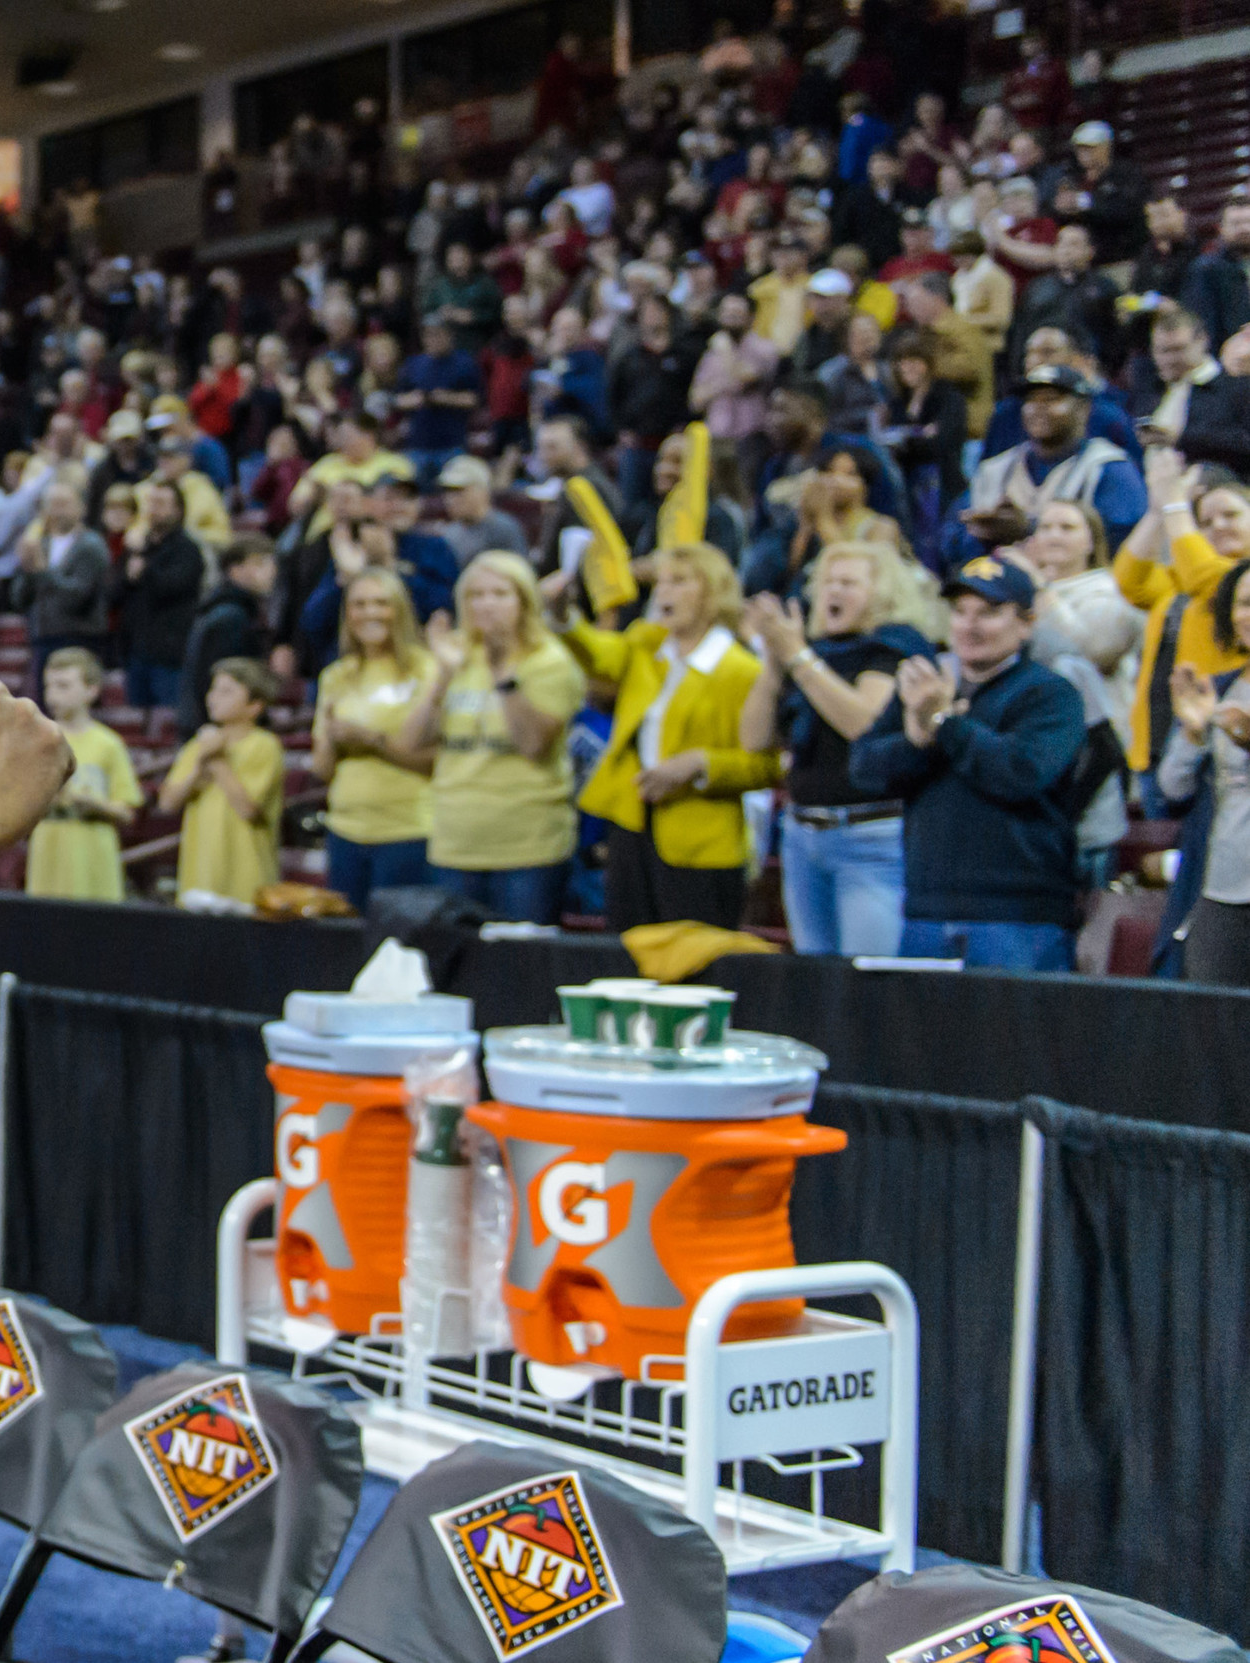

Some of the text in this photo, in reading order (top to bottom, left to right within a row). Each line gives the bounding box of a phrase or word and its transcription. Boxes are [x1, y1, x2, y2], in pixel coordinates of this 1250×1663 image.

[276, 1112, 318, 1188] G
[538, 1161, 608, 1245] G
[728, 1369, 876, 1414] GATORADE
[167, 1427, 249, 1481] NIT
[458, 1482, 556, 1525] NATIONAL
[477, 1526, 586, 1601] NIT
[921, 1606, 1046, 1662] NATIONAL
